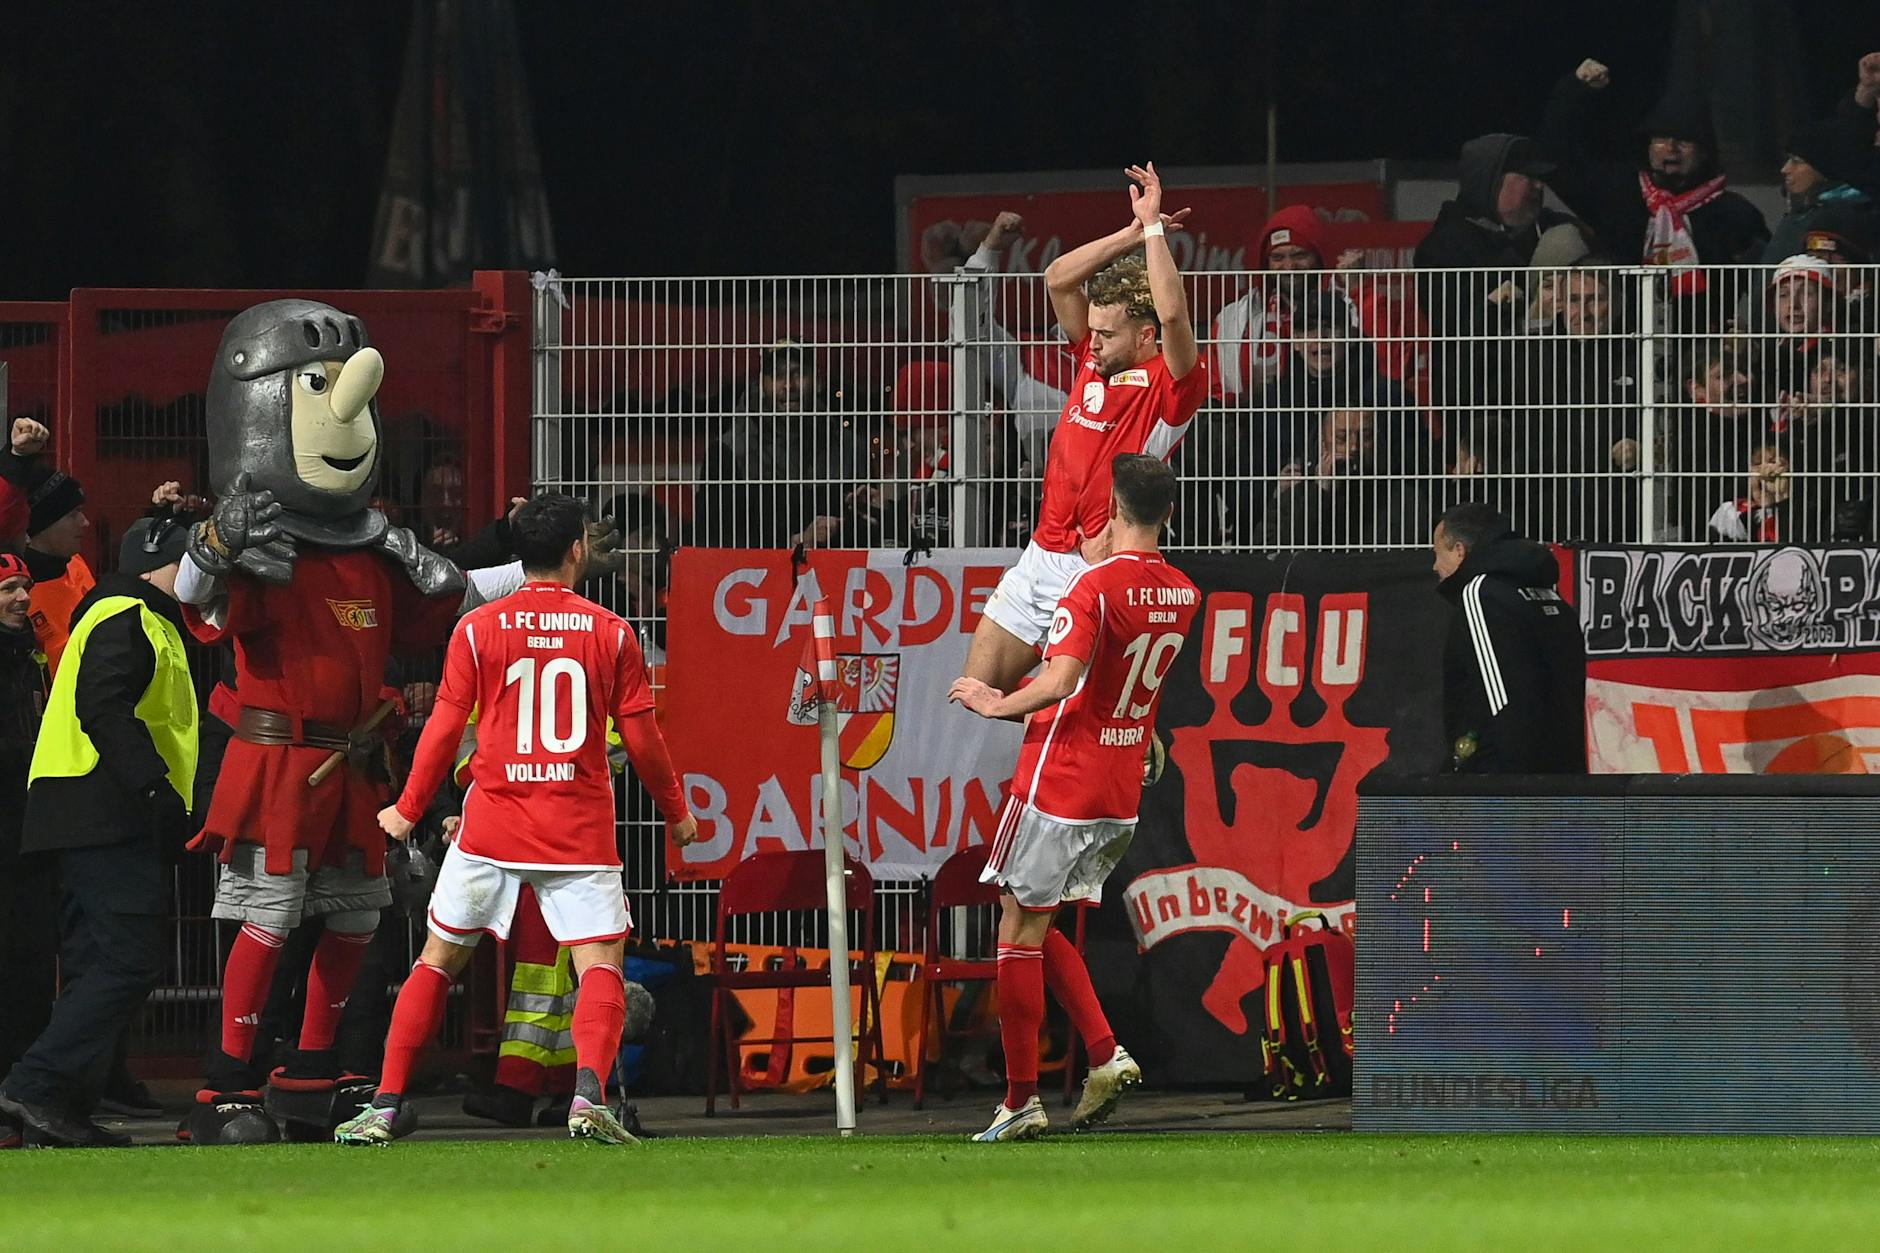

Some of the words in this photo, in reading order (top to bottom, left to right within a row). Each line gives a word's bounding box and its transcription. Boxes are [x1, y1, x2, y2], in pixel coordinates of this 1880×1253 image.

[1126, 588, 1137, 606] 1.
[1139, 588, 1154, 606] FC
[1157, 588, 1195, 606] UNION
[1585, 551, 1754, 653] BACK
[498, 612, 512, 630] 1.
[515, 611, 535, 630] FC
[539, 612, 594, 632] UNION
[1148, 611, 1177, 623] BERLIN
[527, 635, 564, 649] BERLIN
[1112, 632, 1185, 720] 19
[505, 657, 587, 754] 10
[505, 762, 575, 782] VOLLAND
[1371, 1074, 1599, 1108] BUNDESLIGA
